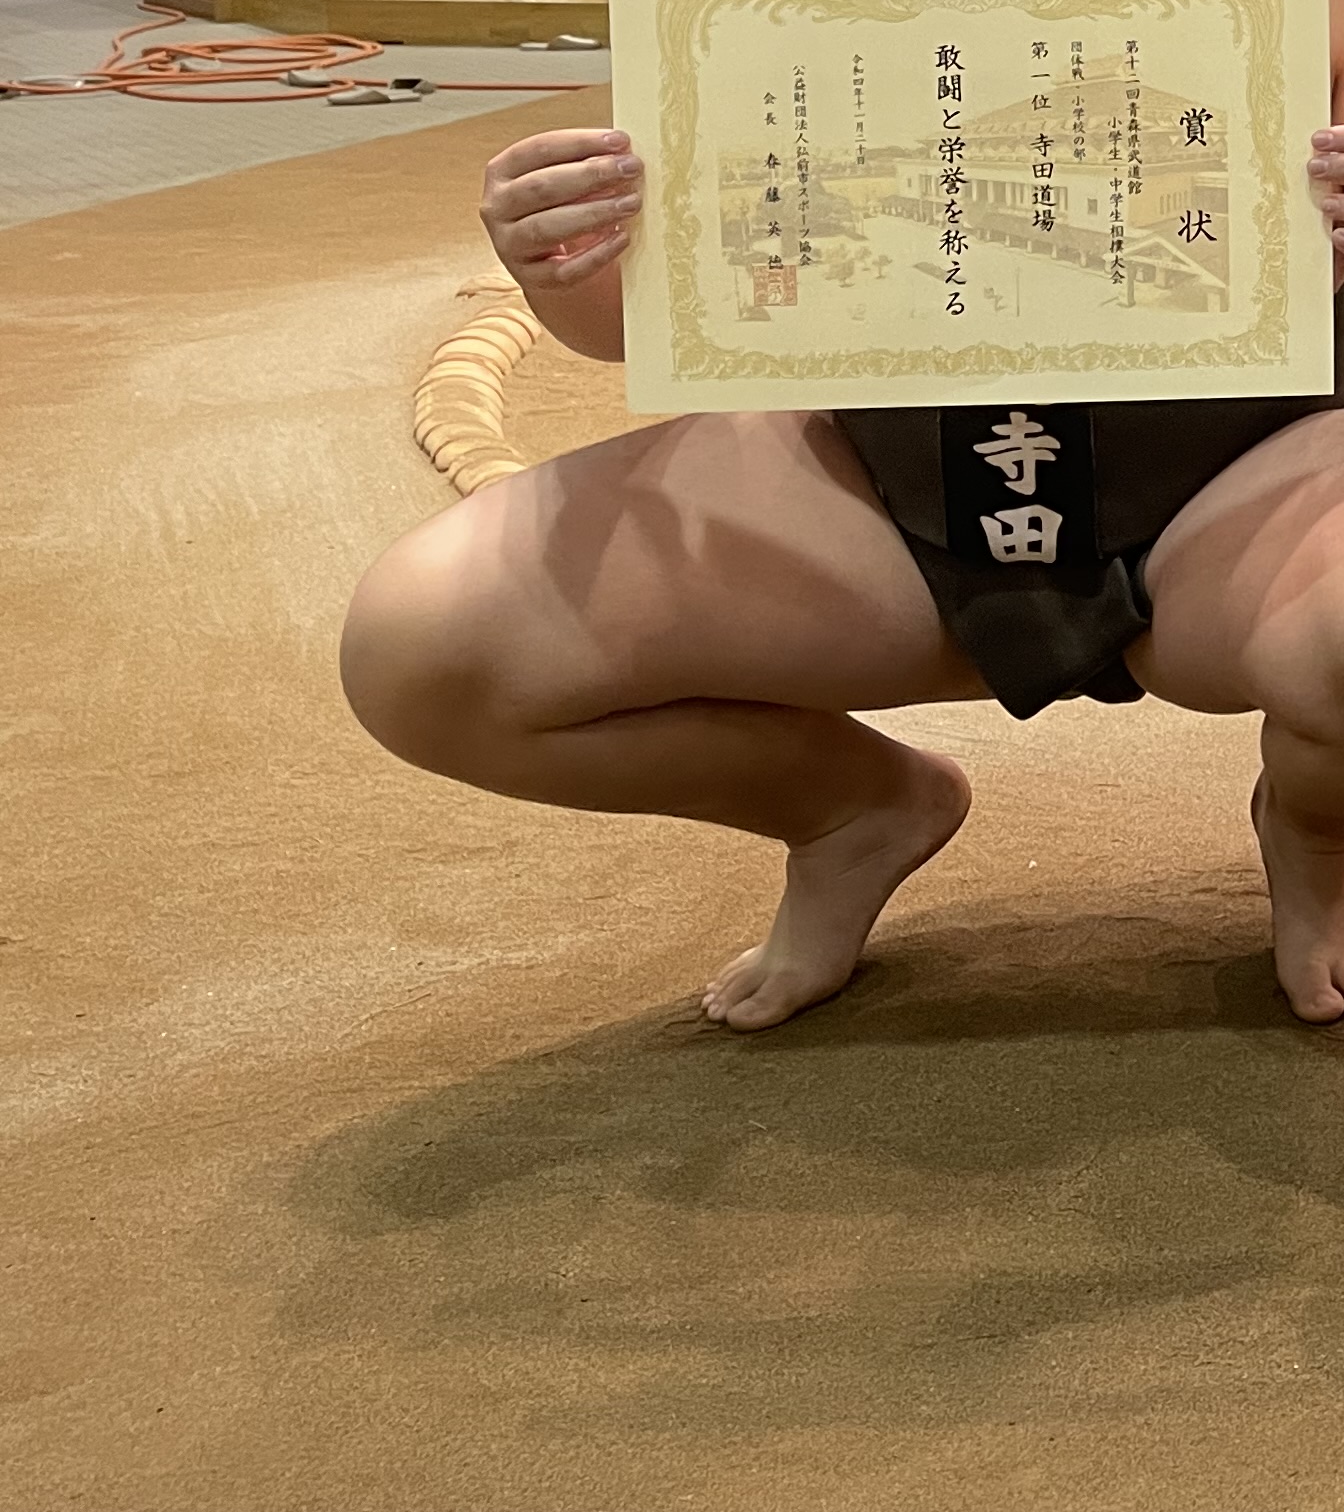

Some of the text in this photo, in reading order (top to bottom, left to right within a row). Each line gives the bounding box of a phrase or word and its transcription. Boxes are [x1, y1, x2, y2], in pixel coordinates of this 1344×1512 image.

[763, 91, 778, 126] 会長
[792, 64, 813, 267] 公益財団法人弘前市スポーツ協会
[851, 53, 867, 165] 令和四年十一月二十日
[934, 44, 969, 317] 敢闘と栄誉を称える
[1030, 41, 1057, 233] 第一位 寺田道場
[1125, 39, 1143, 195] 第十二回青森県武道館
[1177, 107, 1218, 244] 賞状
[1107, 116, 1126, 285] 小学生・中学生相撲大会
[972, 411, 1063, 564] 寺田
